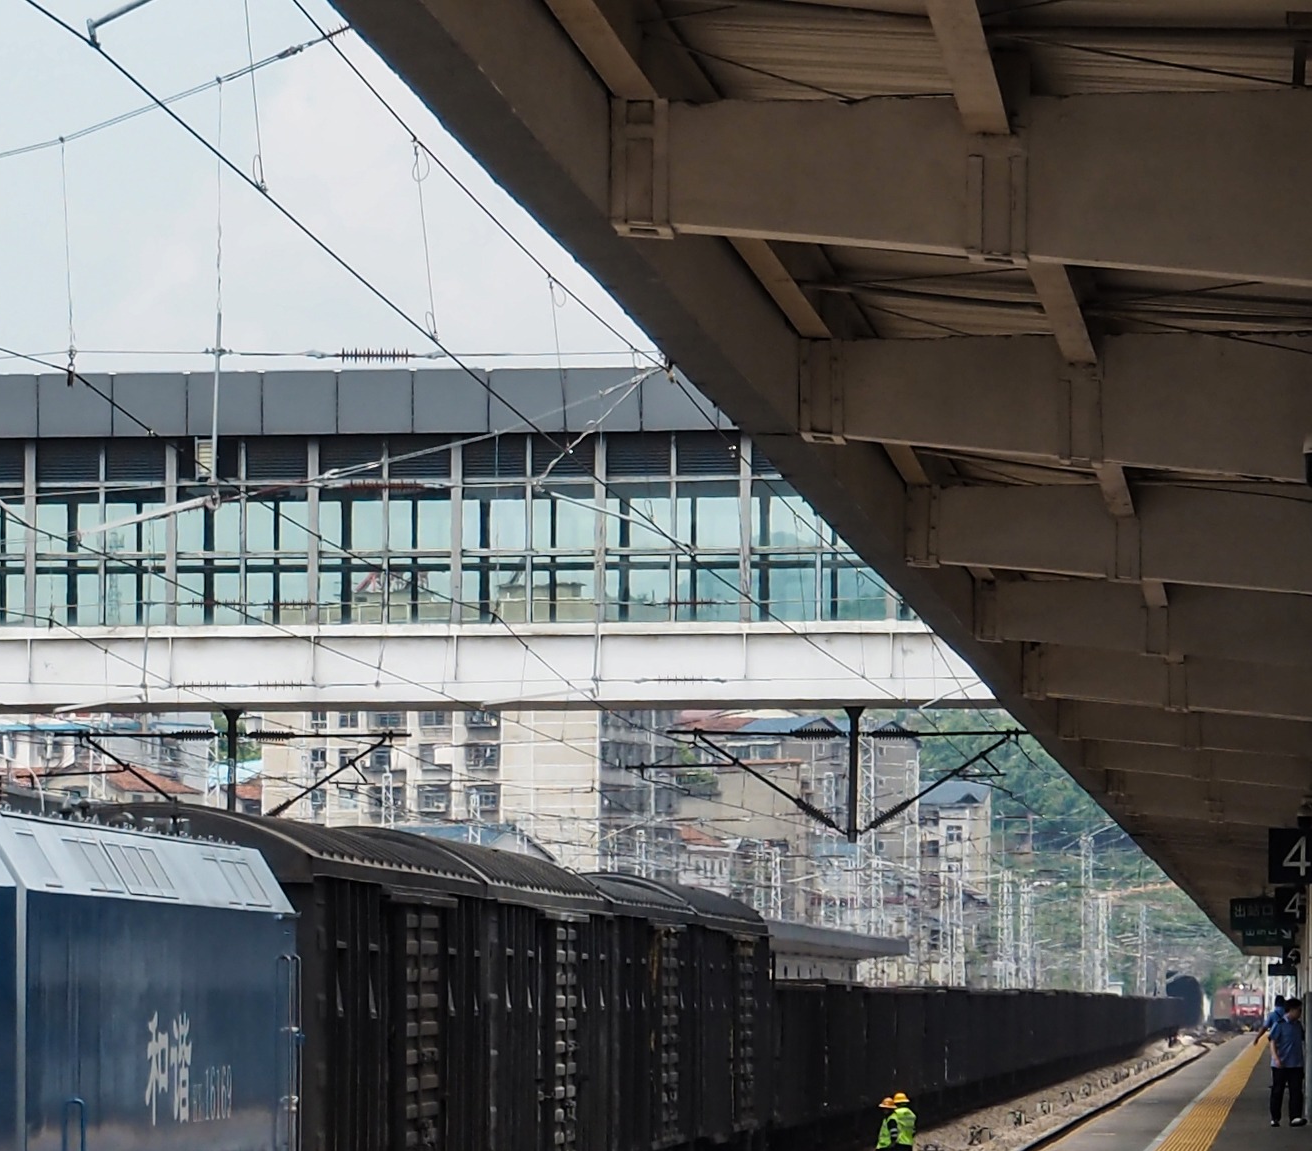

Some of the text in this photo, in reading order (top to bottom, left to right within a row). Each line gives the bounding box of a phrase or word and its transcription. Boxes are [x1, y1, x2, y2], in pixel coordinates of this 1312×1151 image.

[1282, 835, 1311, 877] 4
[1284, 891, 1302, 919] 4
[145, 1011, 193, 1126] 和谐
